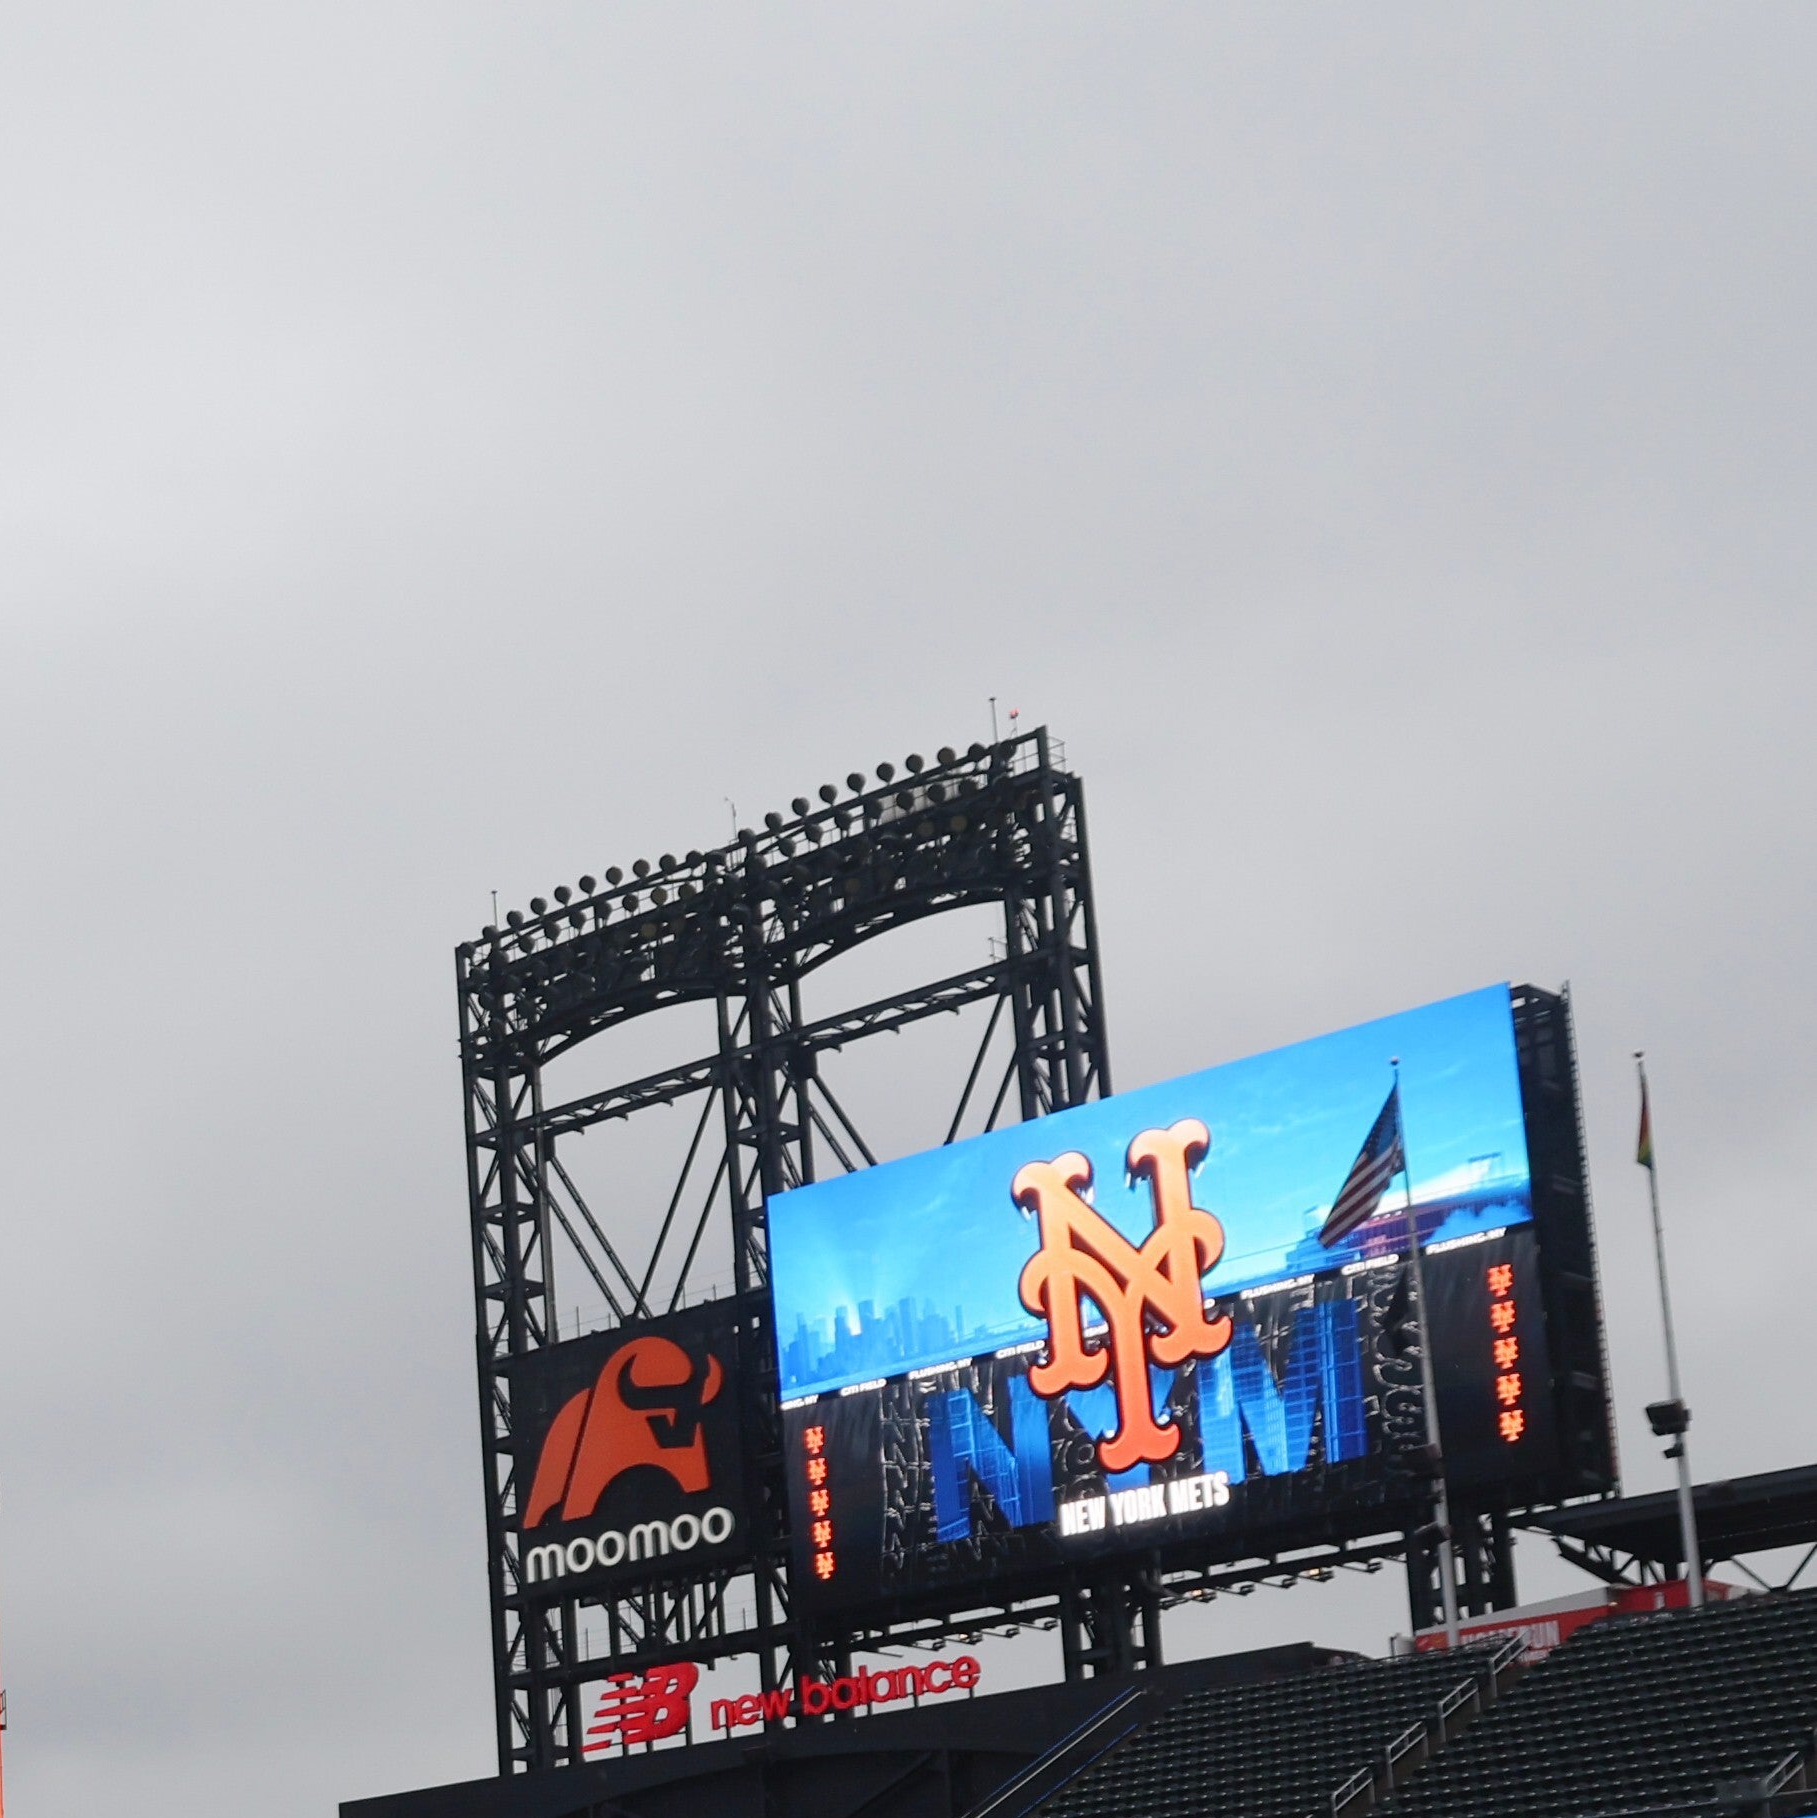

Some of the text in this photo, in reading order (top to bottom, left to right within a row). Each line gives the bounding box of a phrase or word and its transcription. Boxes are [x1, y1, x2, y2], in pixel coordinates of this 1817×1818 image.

[1060, 1472, 1230, 1537] NEW YORK METS
[526, 1507, 734, 1583] moomoo
[712, 1682, 795, 1730] new
[801, 1655, 980, 1716] balance
